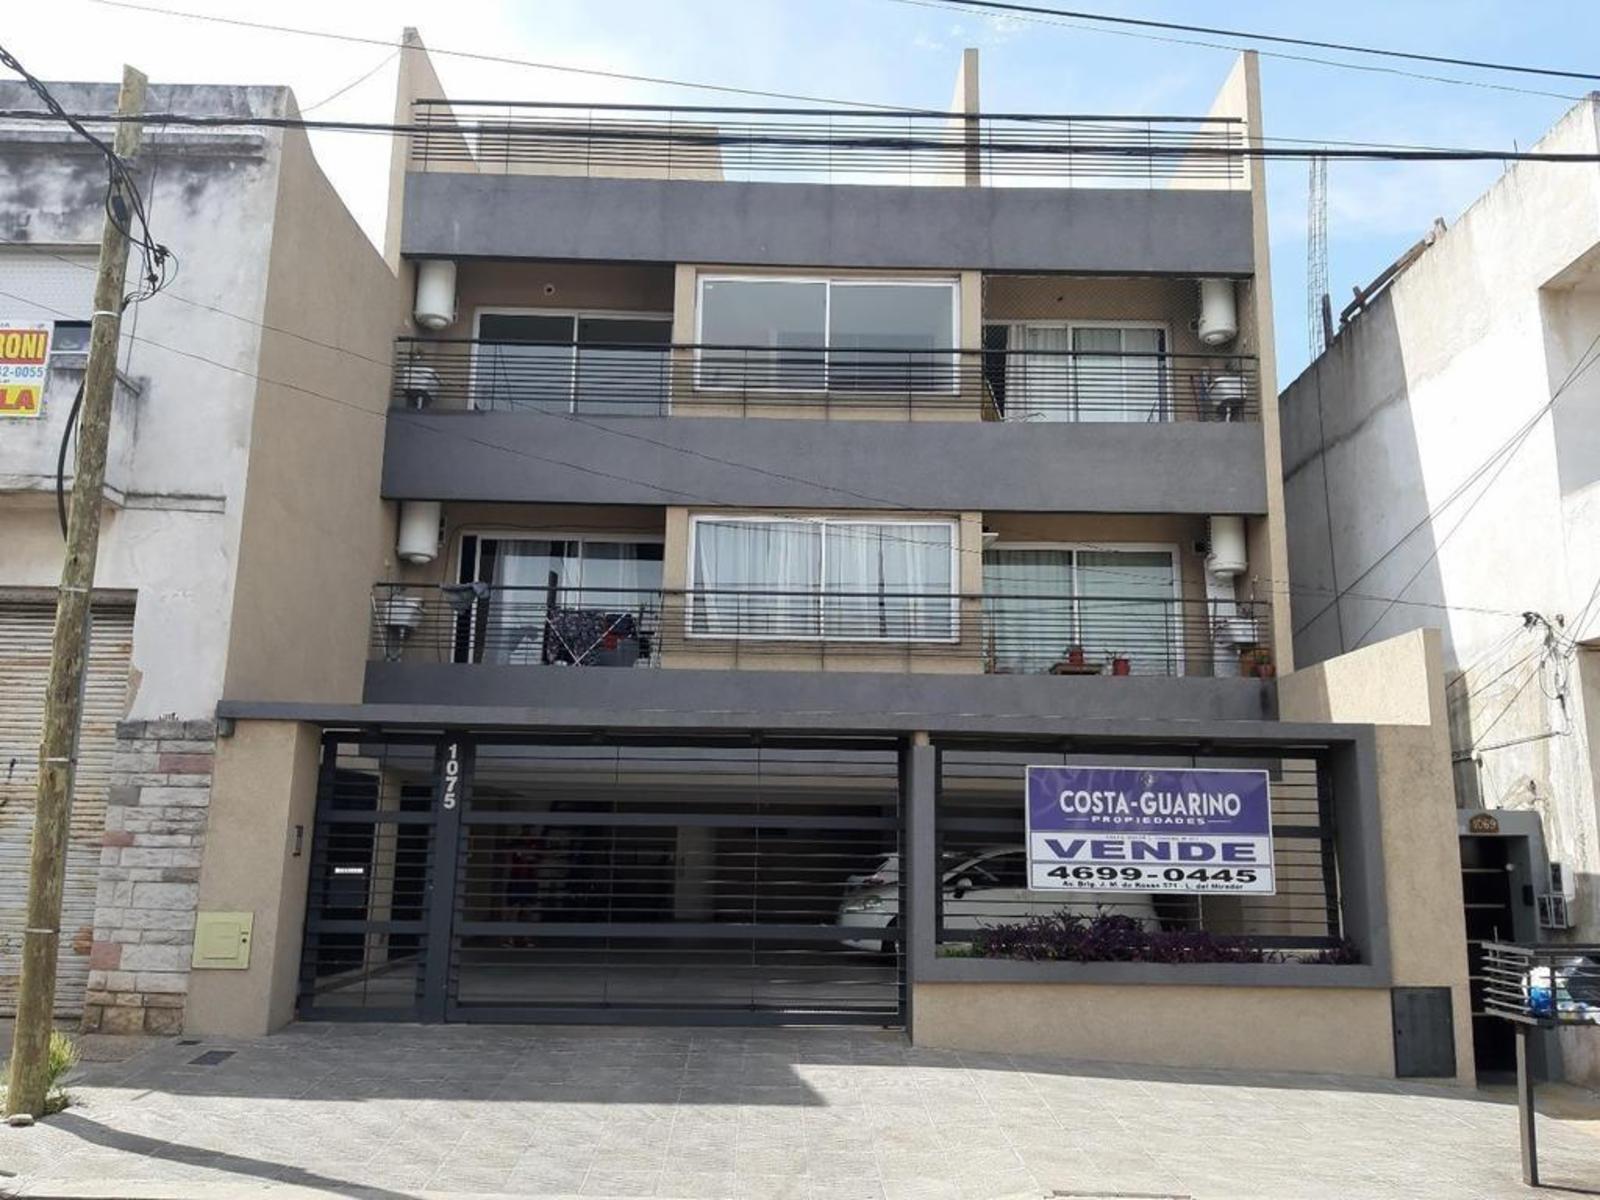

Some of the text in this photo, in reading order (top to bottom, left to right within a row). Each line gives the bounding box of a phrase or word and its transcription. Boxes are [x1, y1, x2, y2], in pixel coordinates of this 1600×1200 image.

[443, 743, 459, 809] 1075
[1060, 790, 1241, 816] COSTA-GUARINO
[1091, 815, 1206, 825] PROPIEDADES
[1044, 839, 1256, 862] VENDE
[1047, 866, 1257, 883] 4699-0445
